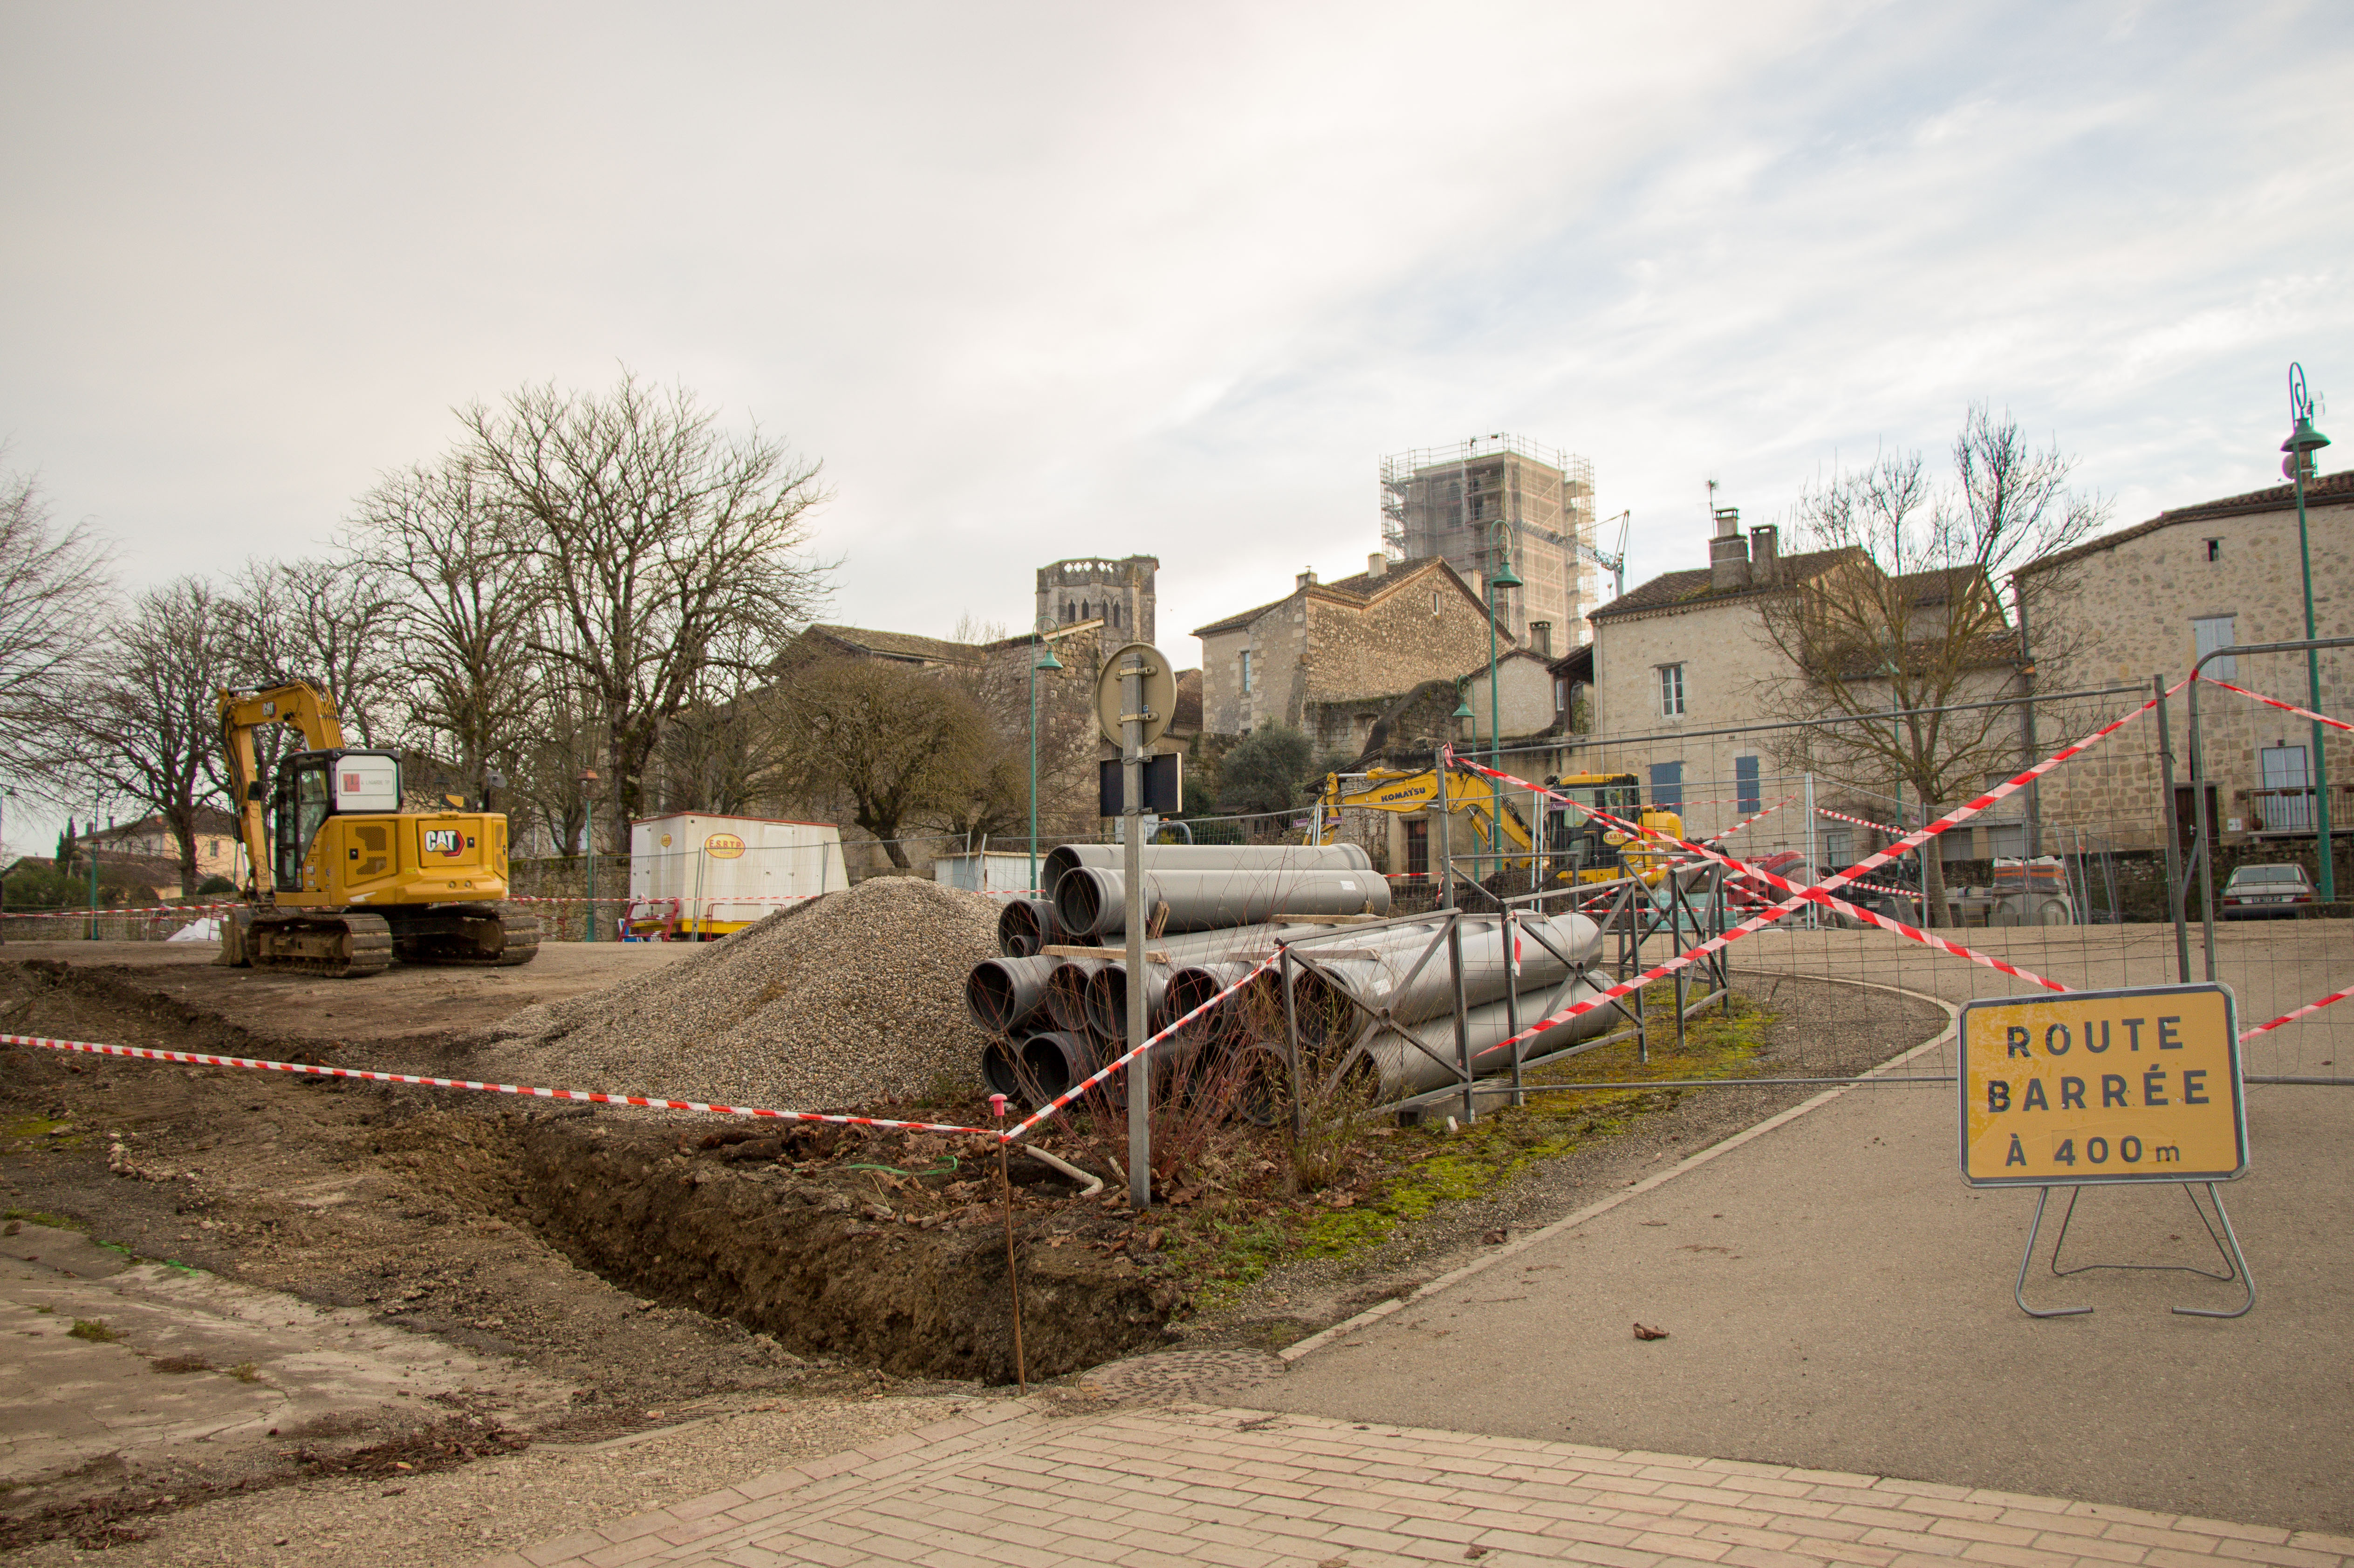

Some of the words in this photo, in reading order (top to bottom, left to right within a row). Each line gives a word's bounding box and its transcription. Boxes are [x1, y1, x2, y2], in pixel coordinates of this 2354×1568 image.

[263, 702, 274, 716] CAT
[1381, 787, 1426, 802] KOMATSU
[425, 830, 456, 852] CAT
[2007, 1016, 2183, 1058] ROUTE
[1988, 1064, 2209, 1112] BARRÉE
[2005, 1133, 2026, 1166] À
